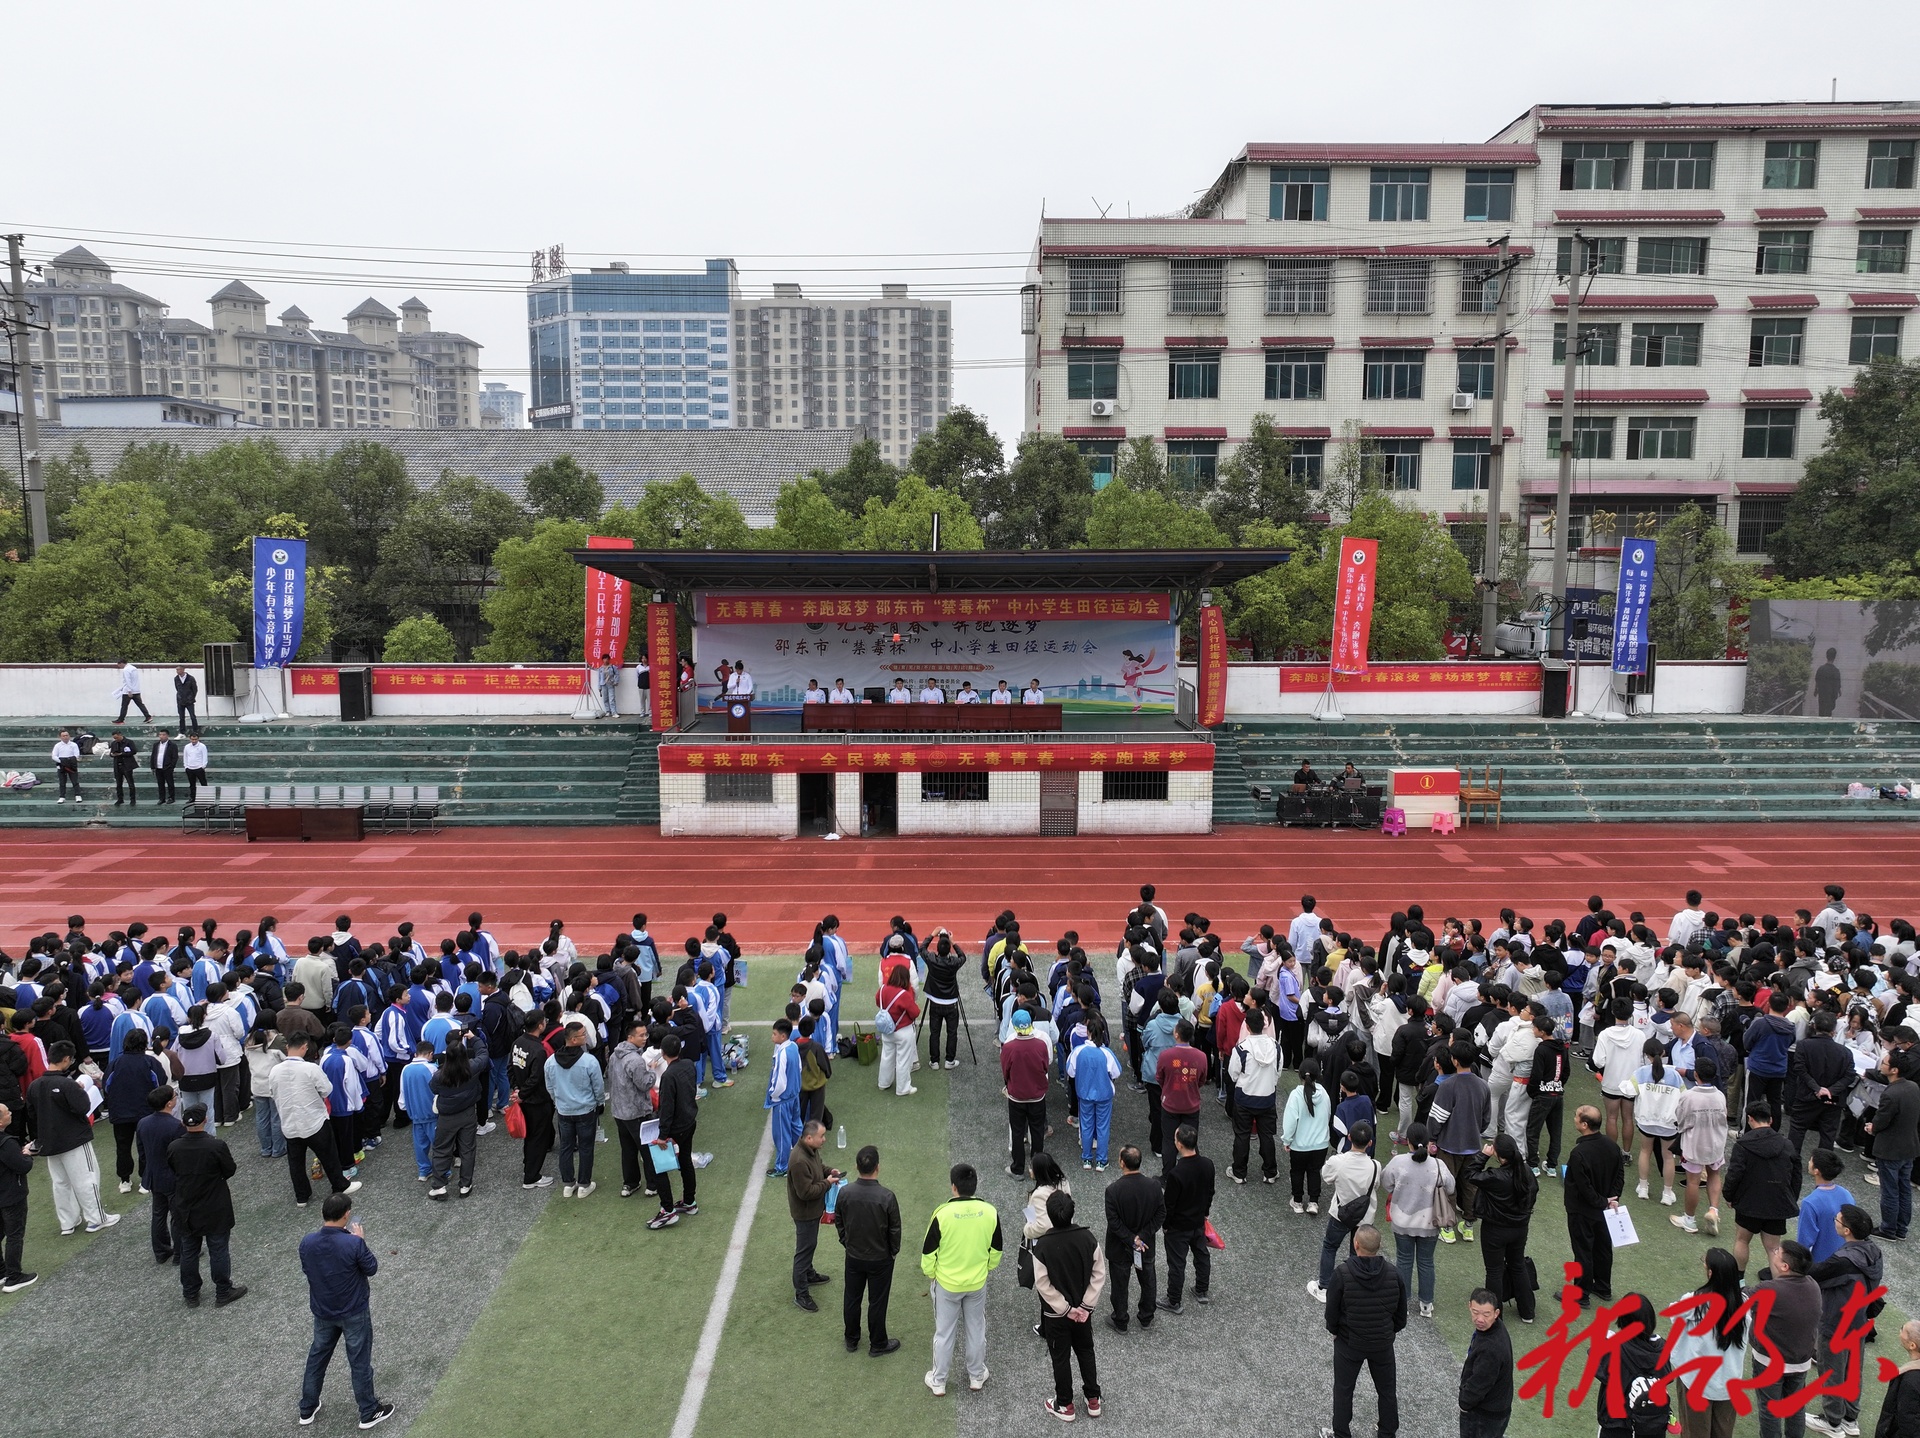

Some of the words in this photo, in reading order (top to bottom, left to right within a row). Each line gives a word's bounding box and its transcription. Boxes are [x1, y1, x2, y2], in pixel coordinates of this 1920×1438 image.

[281, 568, 295, 659] 田径逐梦正当时
[717, 599, 870, 619] 无毒青春·奔跑逐梦
[655, 607, 671, 666] 运动点燃激情
[1206, 609, 1221, 669] 同心同行拒毒品
[390, 673, 467, 686] 拒绝毒品
[484, 673, 582, 687] 拒绝兴奋剂
[1360, 671, 1421, 683] 青春滚烫
[1429, 671, 1492, 683] 赛场逐梦
[1499, 671, 1542, 683] 锋芒万
[657, 670, 673, 728] 禁毒守护家园
[686, 751, 919, 768] 爱我邵东·全民禁毒
[957, 750, 1188, 767] 无毒青春·奔跑逐梦
